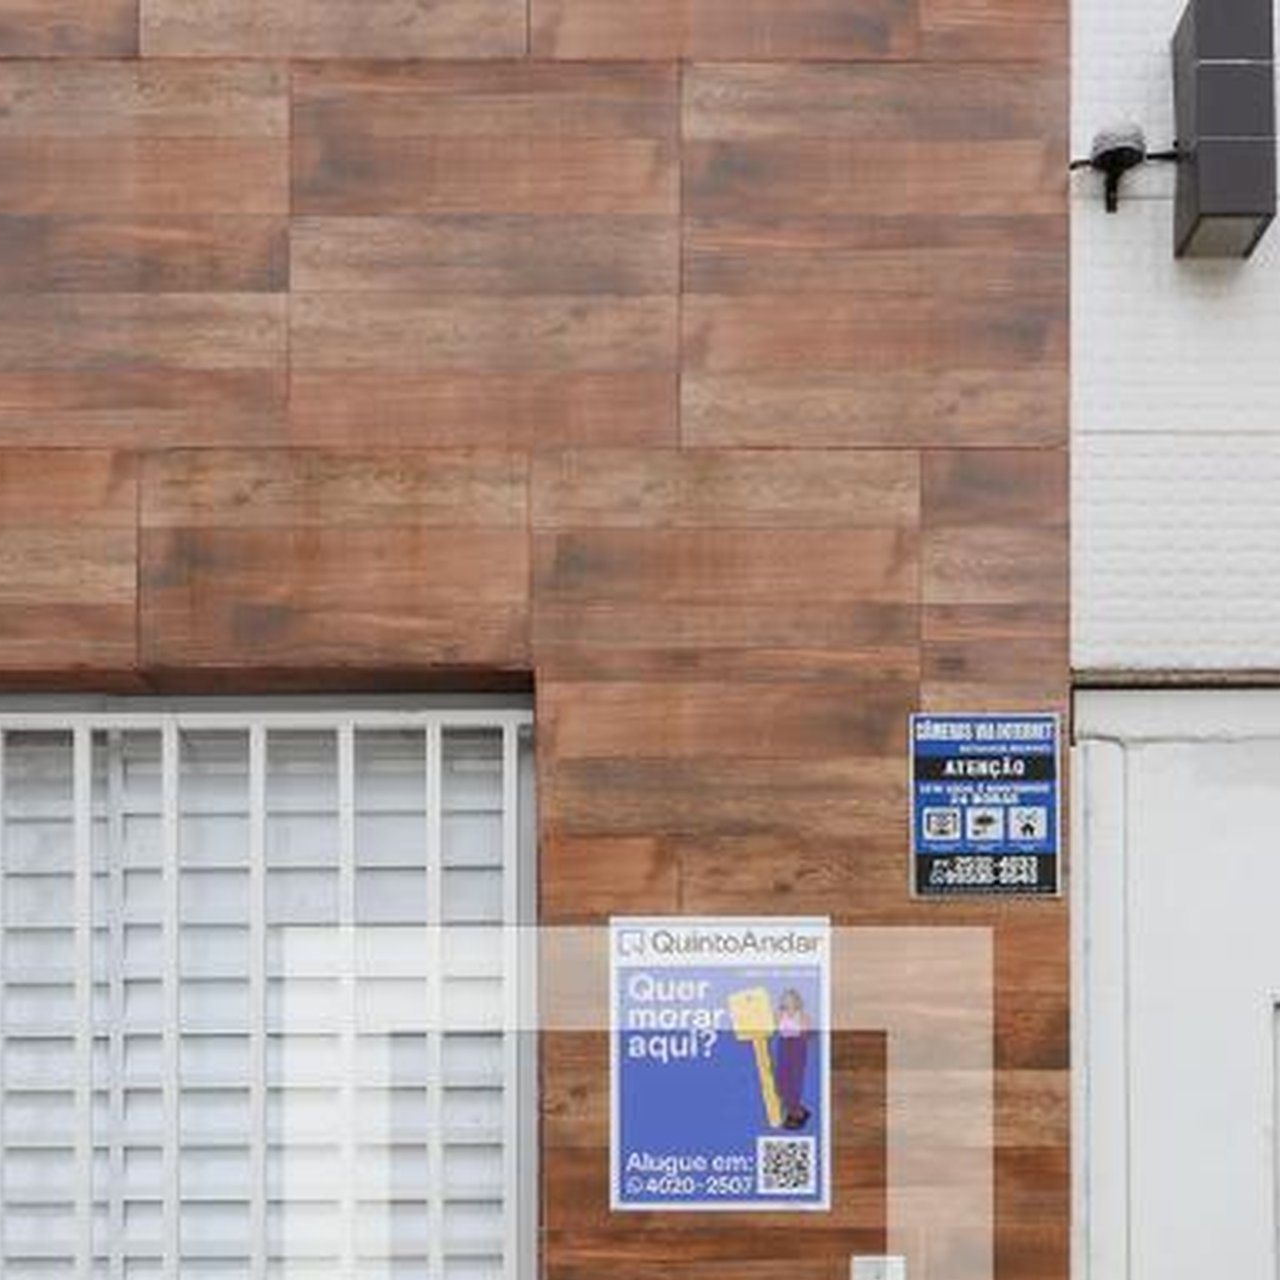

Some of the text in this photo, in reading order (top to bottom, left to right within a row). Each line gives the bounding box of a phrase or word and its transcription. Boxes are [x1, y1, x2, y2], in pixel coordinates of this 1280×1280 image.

[943, 757, 1025, 779] ATENÇÃO
[651, 930, 821, 956] QuintoAndar
[628, 975, 711, 1003] Quer
[628, 1007, 725, 1030] morar
[628, 1030, 718, 1062] aqui?
[626, 1151, 754, 1177] Alugue em:
